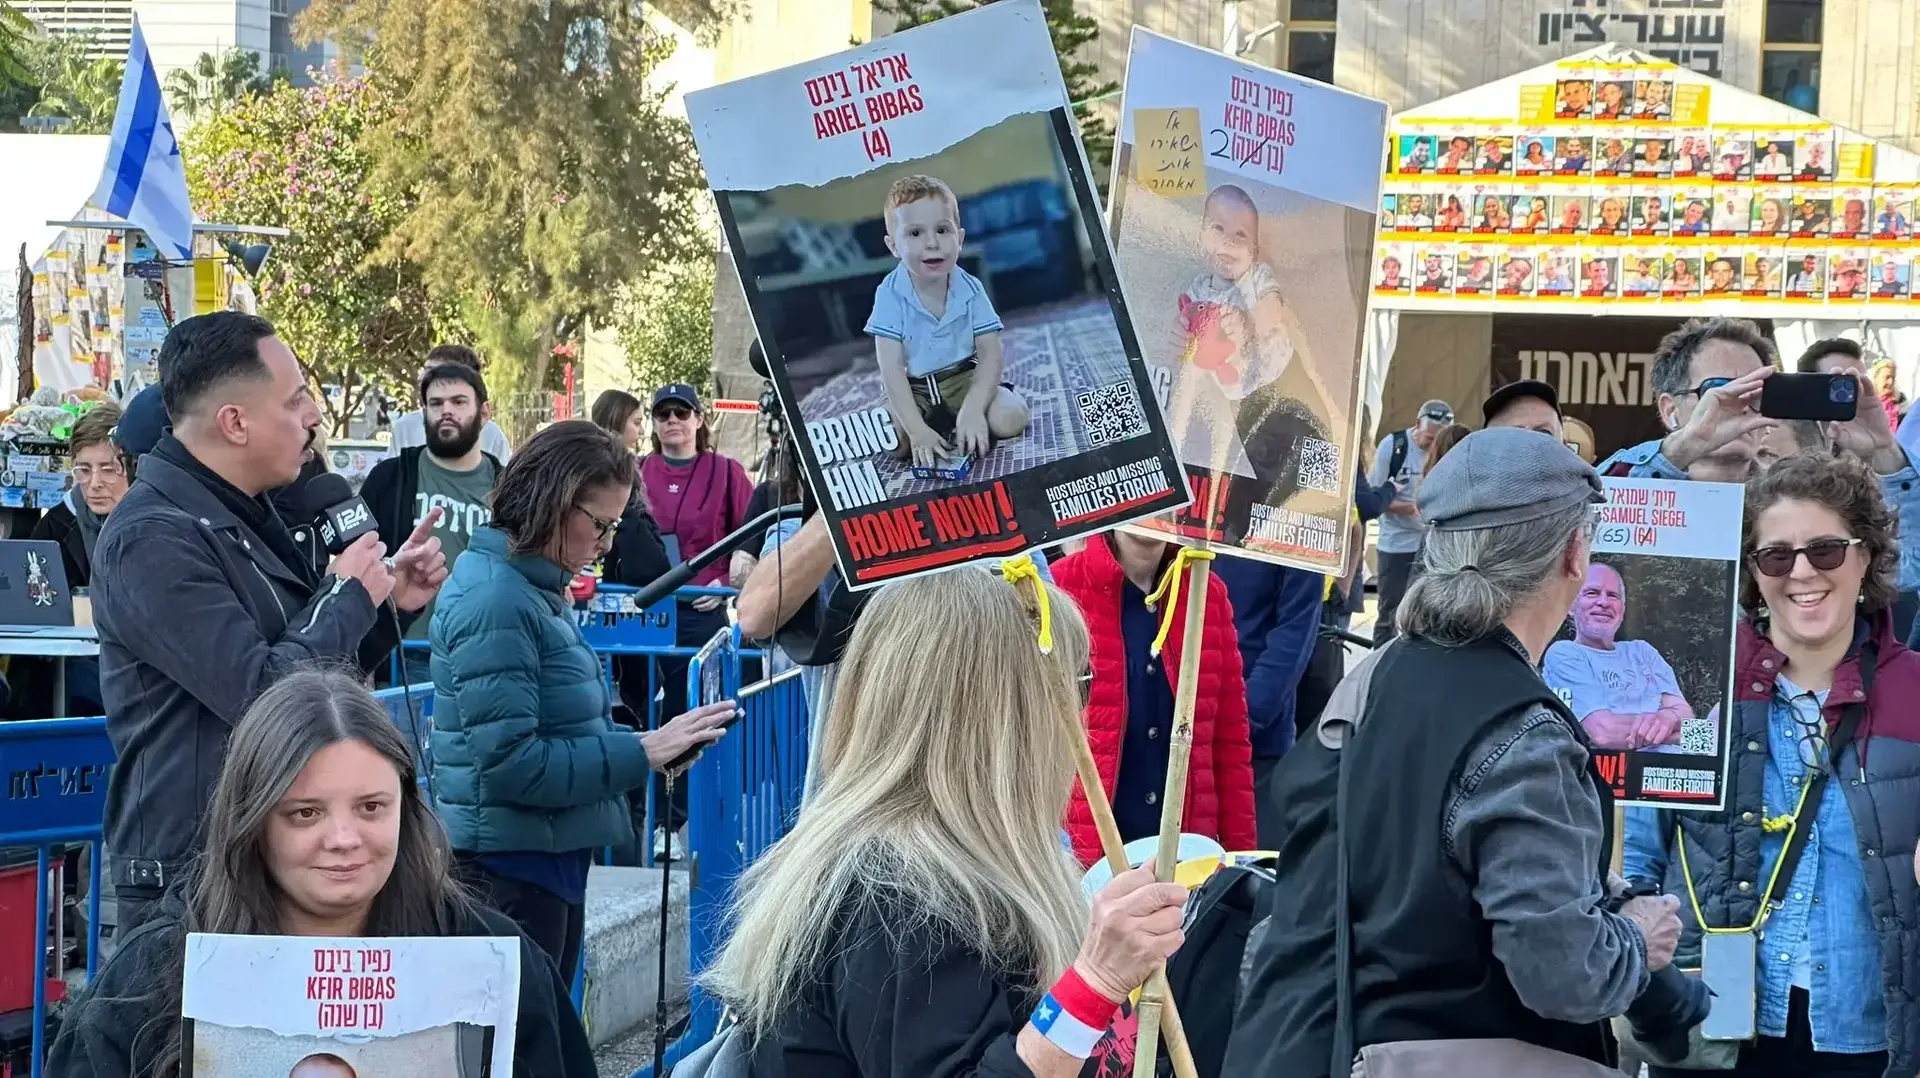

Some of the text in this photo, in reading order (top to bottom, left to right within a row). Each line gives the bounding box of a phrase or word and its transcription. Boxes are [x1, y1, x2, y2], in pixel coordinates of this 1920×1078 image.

[804, 52, 912, 107] אריאל ביבס
[1231, 75, 1293, 117] כפיר ביבס
[813, 84, 924, 140] ARIEL BIBAS
[1165, 110, 1180, 130] אל
[1224, 102, 1296, 147] KFIR BIBAS
[862, 126, 892, 162] (4)
[1210, 128, 1231, 159] 2
[1267, 143, 1284, 175] (בן
[1156, 155, 1191, 172] אותי
[1151, 175, 1195, 190] מאחור
[804, 406, 899, 466] BRING
[822, 460, 888, 512] HIM
[1045, 456, 1162, 502] HOSTAGES AND MISSING
[1050, 470, 1169, 522] FAMILIES FORUM
[1609, 487, 1649, 506] שמואל
[336, 503, 368, 532] i24
[841, 480, 1019, 562] HOME NOW!
[1250, 502, 1337, 533] HOSTAGES AND MISSING
[1602, 506, 1687, 527] SAMUEL SIEGEL
[1247, 517, 1336, 554] FAMILIES FORUM
[1642, 767, 1716, 780] HOSTAGES AND MISSING
[1642, 776, 1715, 795] FAMILIES FORUM
[313, 949, 391, 973] כפיר ביבס
[307, 976, 396, 1000] KFIR BIBAS
[318, 1002, 384, 1030] (בן שנה)
